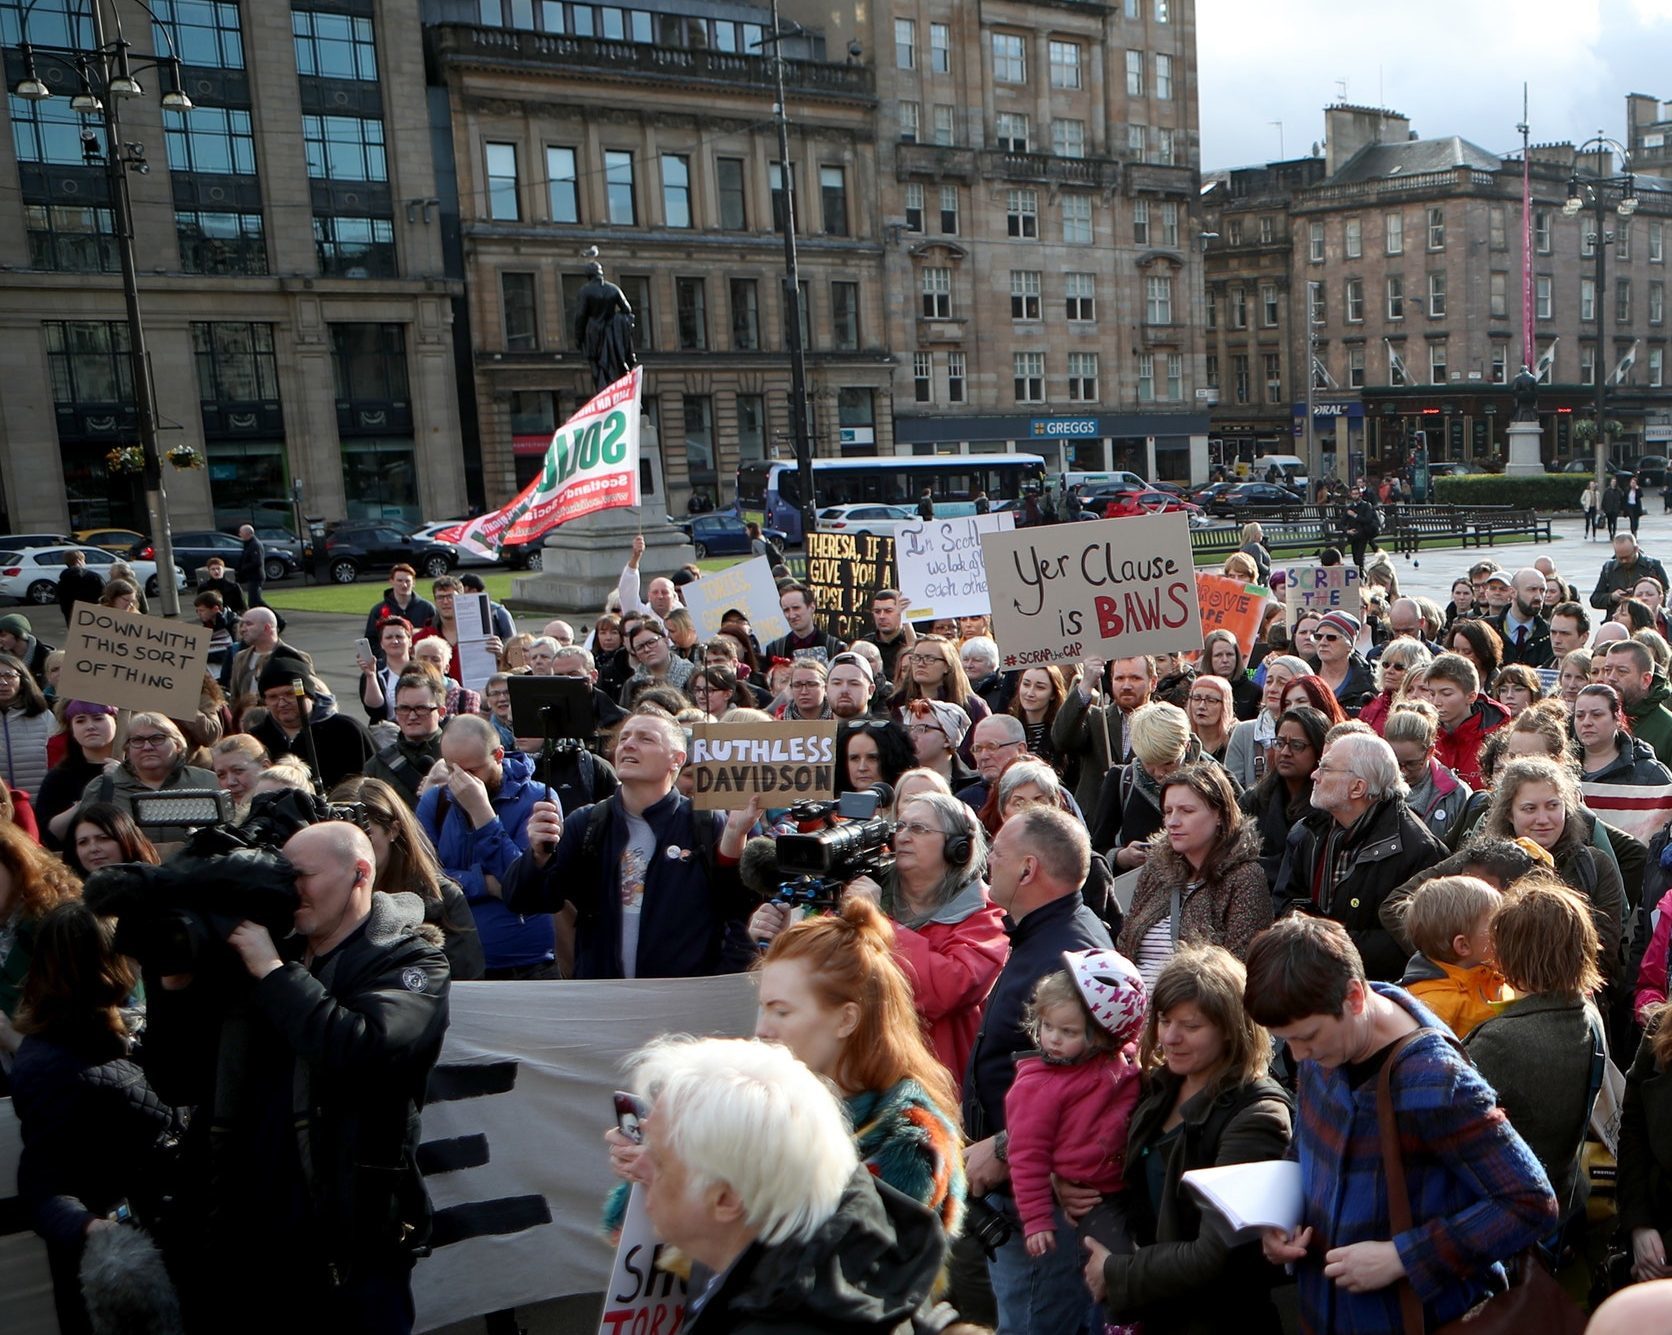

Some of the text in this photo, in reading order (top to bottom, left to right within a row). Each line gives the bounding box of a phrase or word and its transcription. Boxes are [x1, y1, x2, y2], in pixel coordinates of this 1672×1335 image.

[1313, 404, 1343, 416] ORAL
[1046, 421, 1095, 435] GREGGS
[807, 533, 894, 562] THERESA, IF I
[901, 523, 934, 558] In
[810, 559, 892, 589] GIVE YOU A
[925, 575, 989, 598] each othe
[1013, 542, 1179, 616] Yer Clause
[1287, 568, 1359, 590] SCRAP
[810, 584, 845, 612] PEPSI
[1094, 582, 1189, 640] BAWS
[1197, 583, 1252, 614] ROVE
[1302, 589, 1340, 606] THE
[78, 610, 197, 650] DOWN WITH
[1058, 608, 1083, 637] is
[81, 634, 195, 670] THIS SORT
[76, 659, 174, 690] OF THING
[693, 735, 833, 764] RUTHLESS
[696, 764, 832, 793] DAVIDSON
